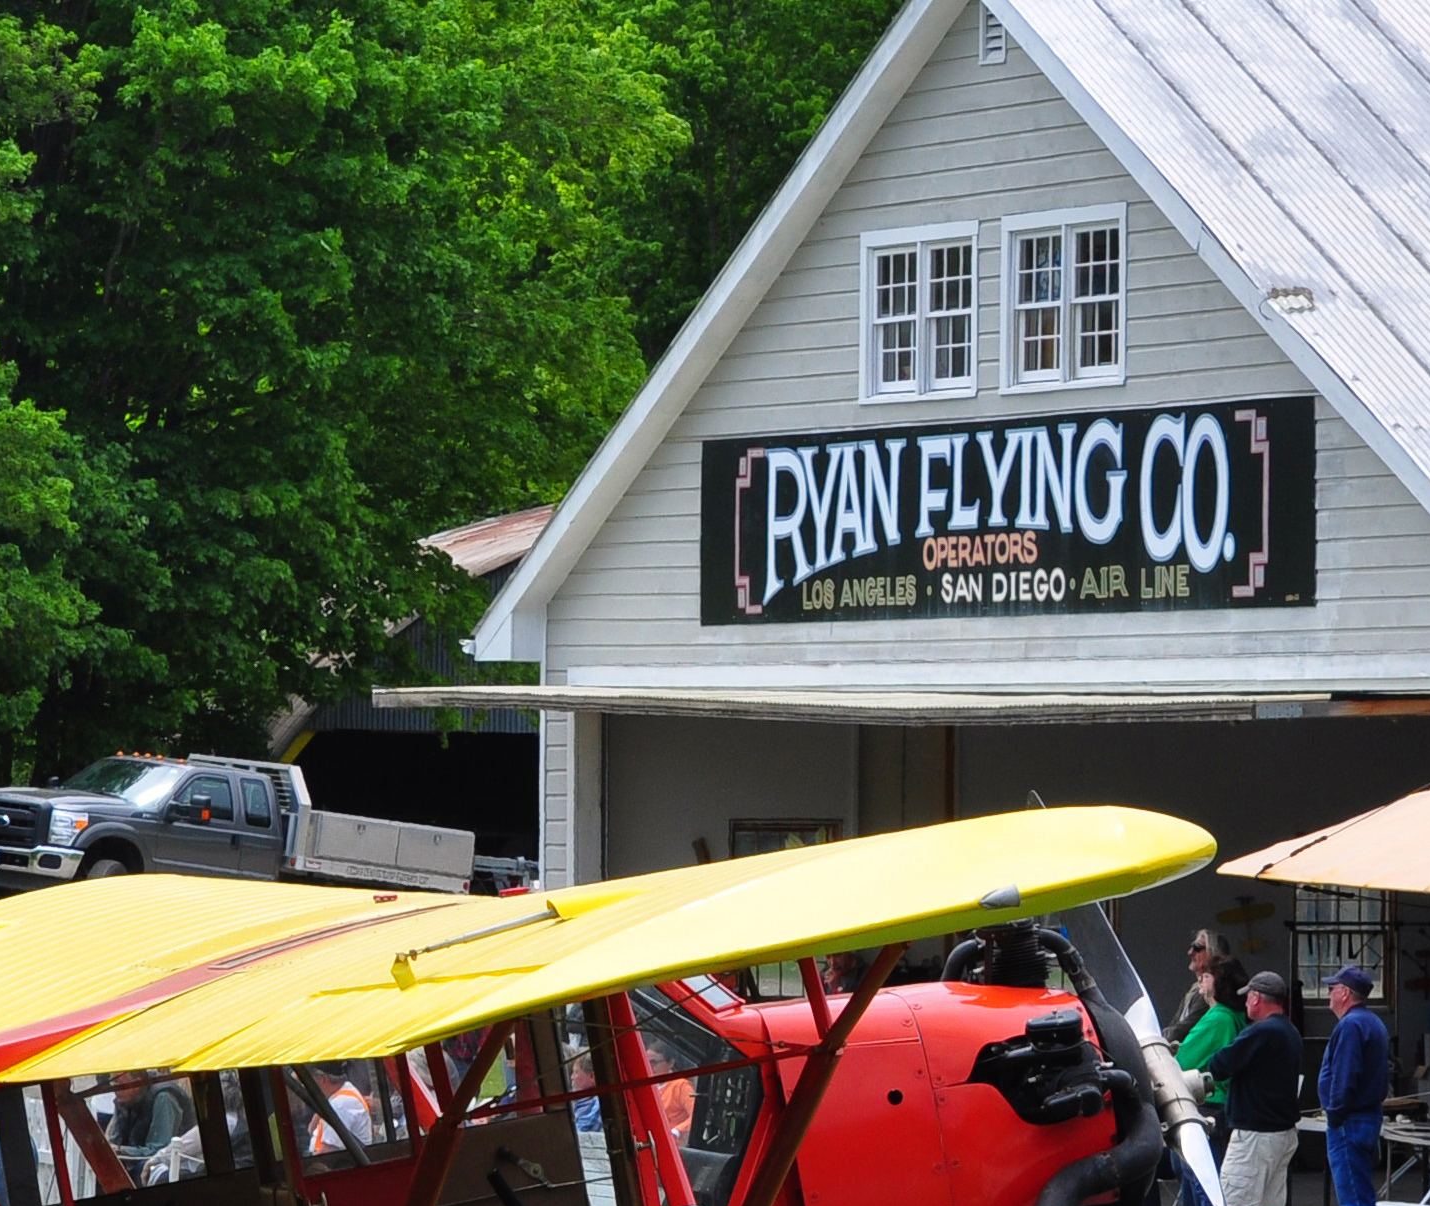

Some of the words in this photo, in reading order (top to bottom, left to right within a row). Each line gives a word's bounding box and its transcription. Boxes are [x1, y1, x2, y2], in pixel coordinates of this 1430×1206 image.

[762, 436, 907, 606] RYAN
[915, 417, 1128, 545] FLYING
[1139, 412, 1236, 574] CO.
[922, 530, 1039, 571] OPERATORS
[802, 580, 835, 611] LOS
[839, 574, 918, 608] ANGELES
[940, 571, 984, 603] SAN
[992, 566, 1066, 603] DIEGO
[1079, 563, 1129, 600] AIR
[1140, 563, 1191, 599] LINE
